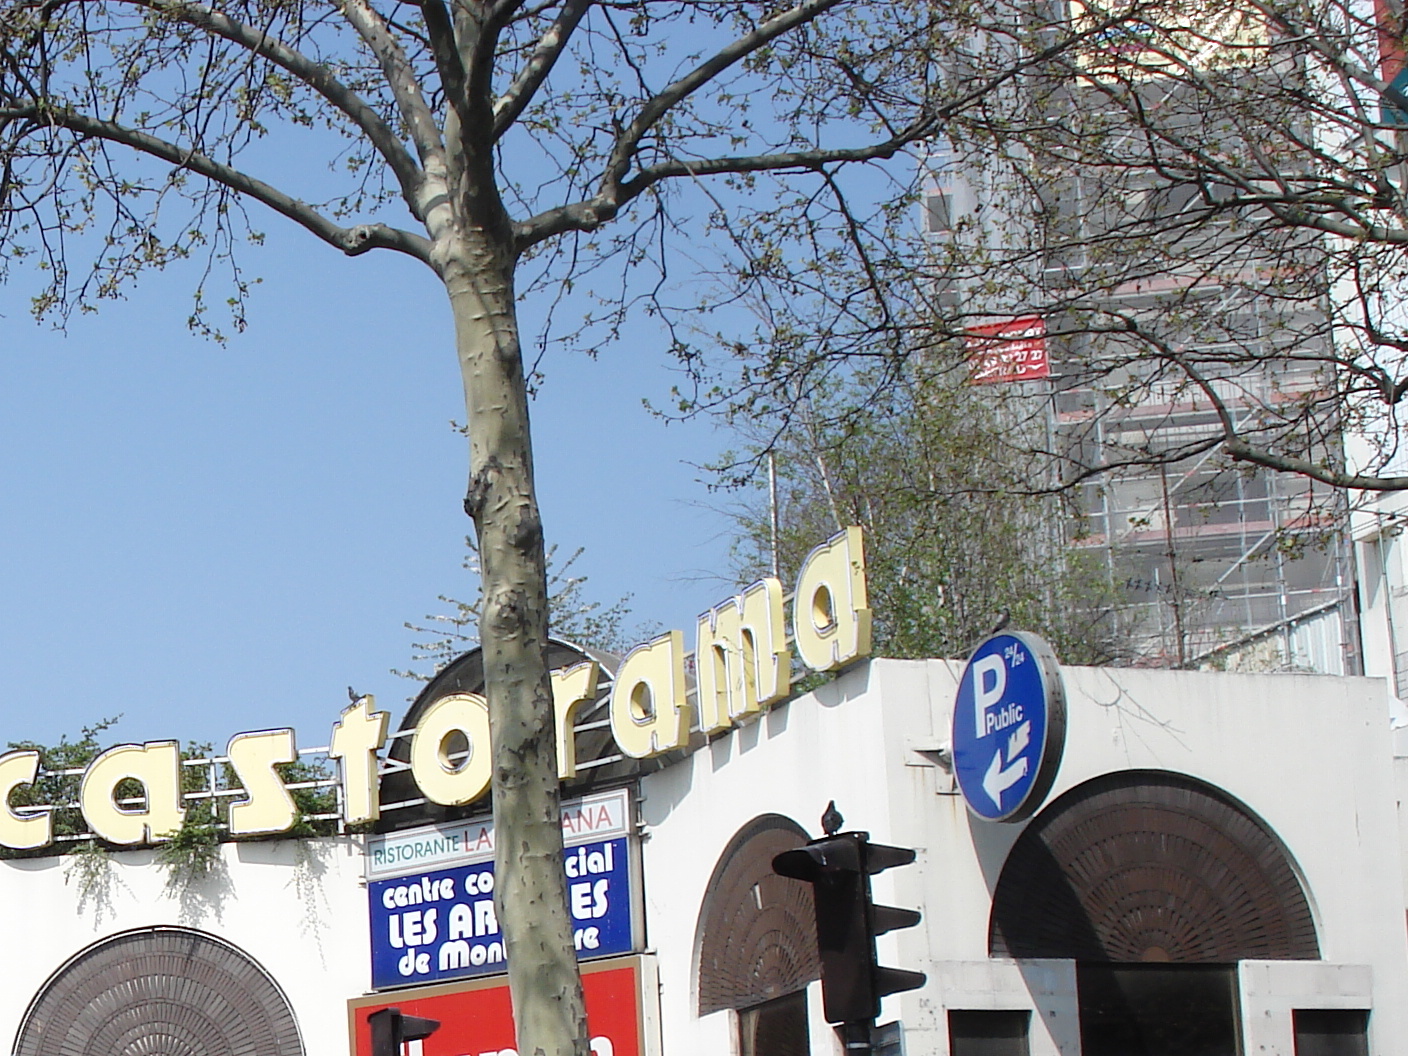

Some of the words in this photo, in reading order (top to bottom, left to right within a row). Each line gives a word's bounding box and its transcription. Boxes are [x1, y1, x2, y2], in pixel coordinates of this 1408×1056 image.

[972, 653, 1007, 739] P
[986, 703, 1024, 734] Public
[374, 835, 459, 866] RISTORANTE
[382, 876, 455, 909] centre
[388, 908, 437, 949] LES
[398, 947, 430, 976] de
